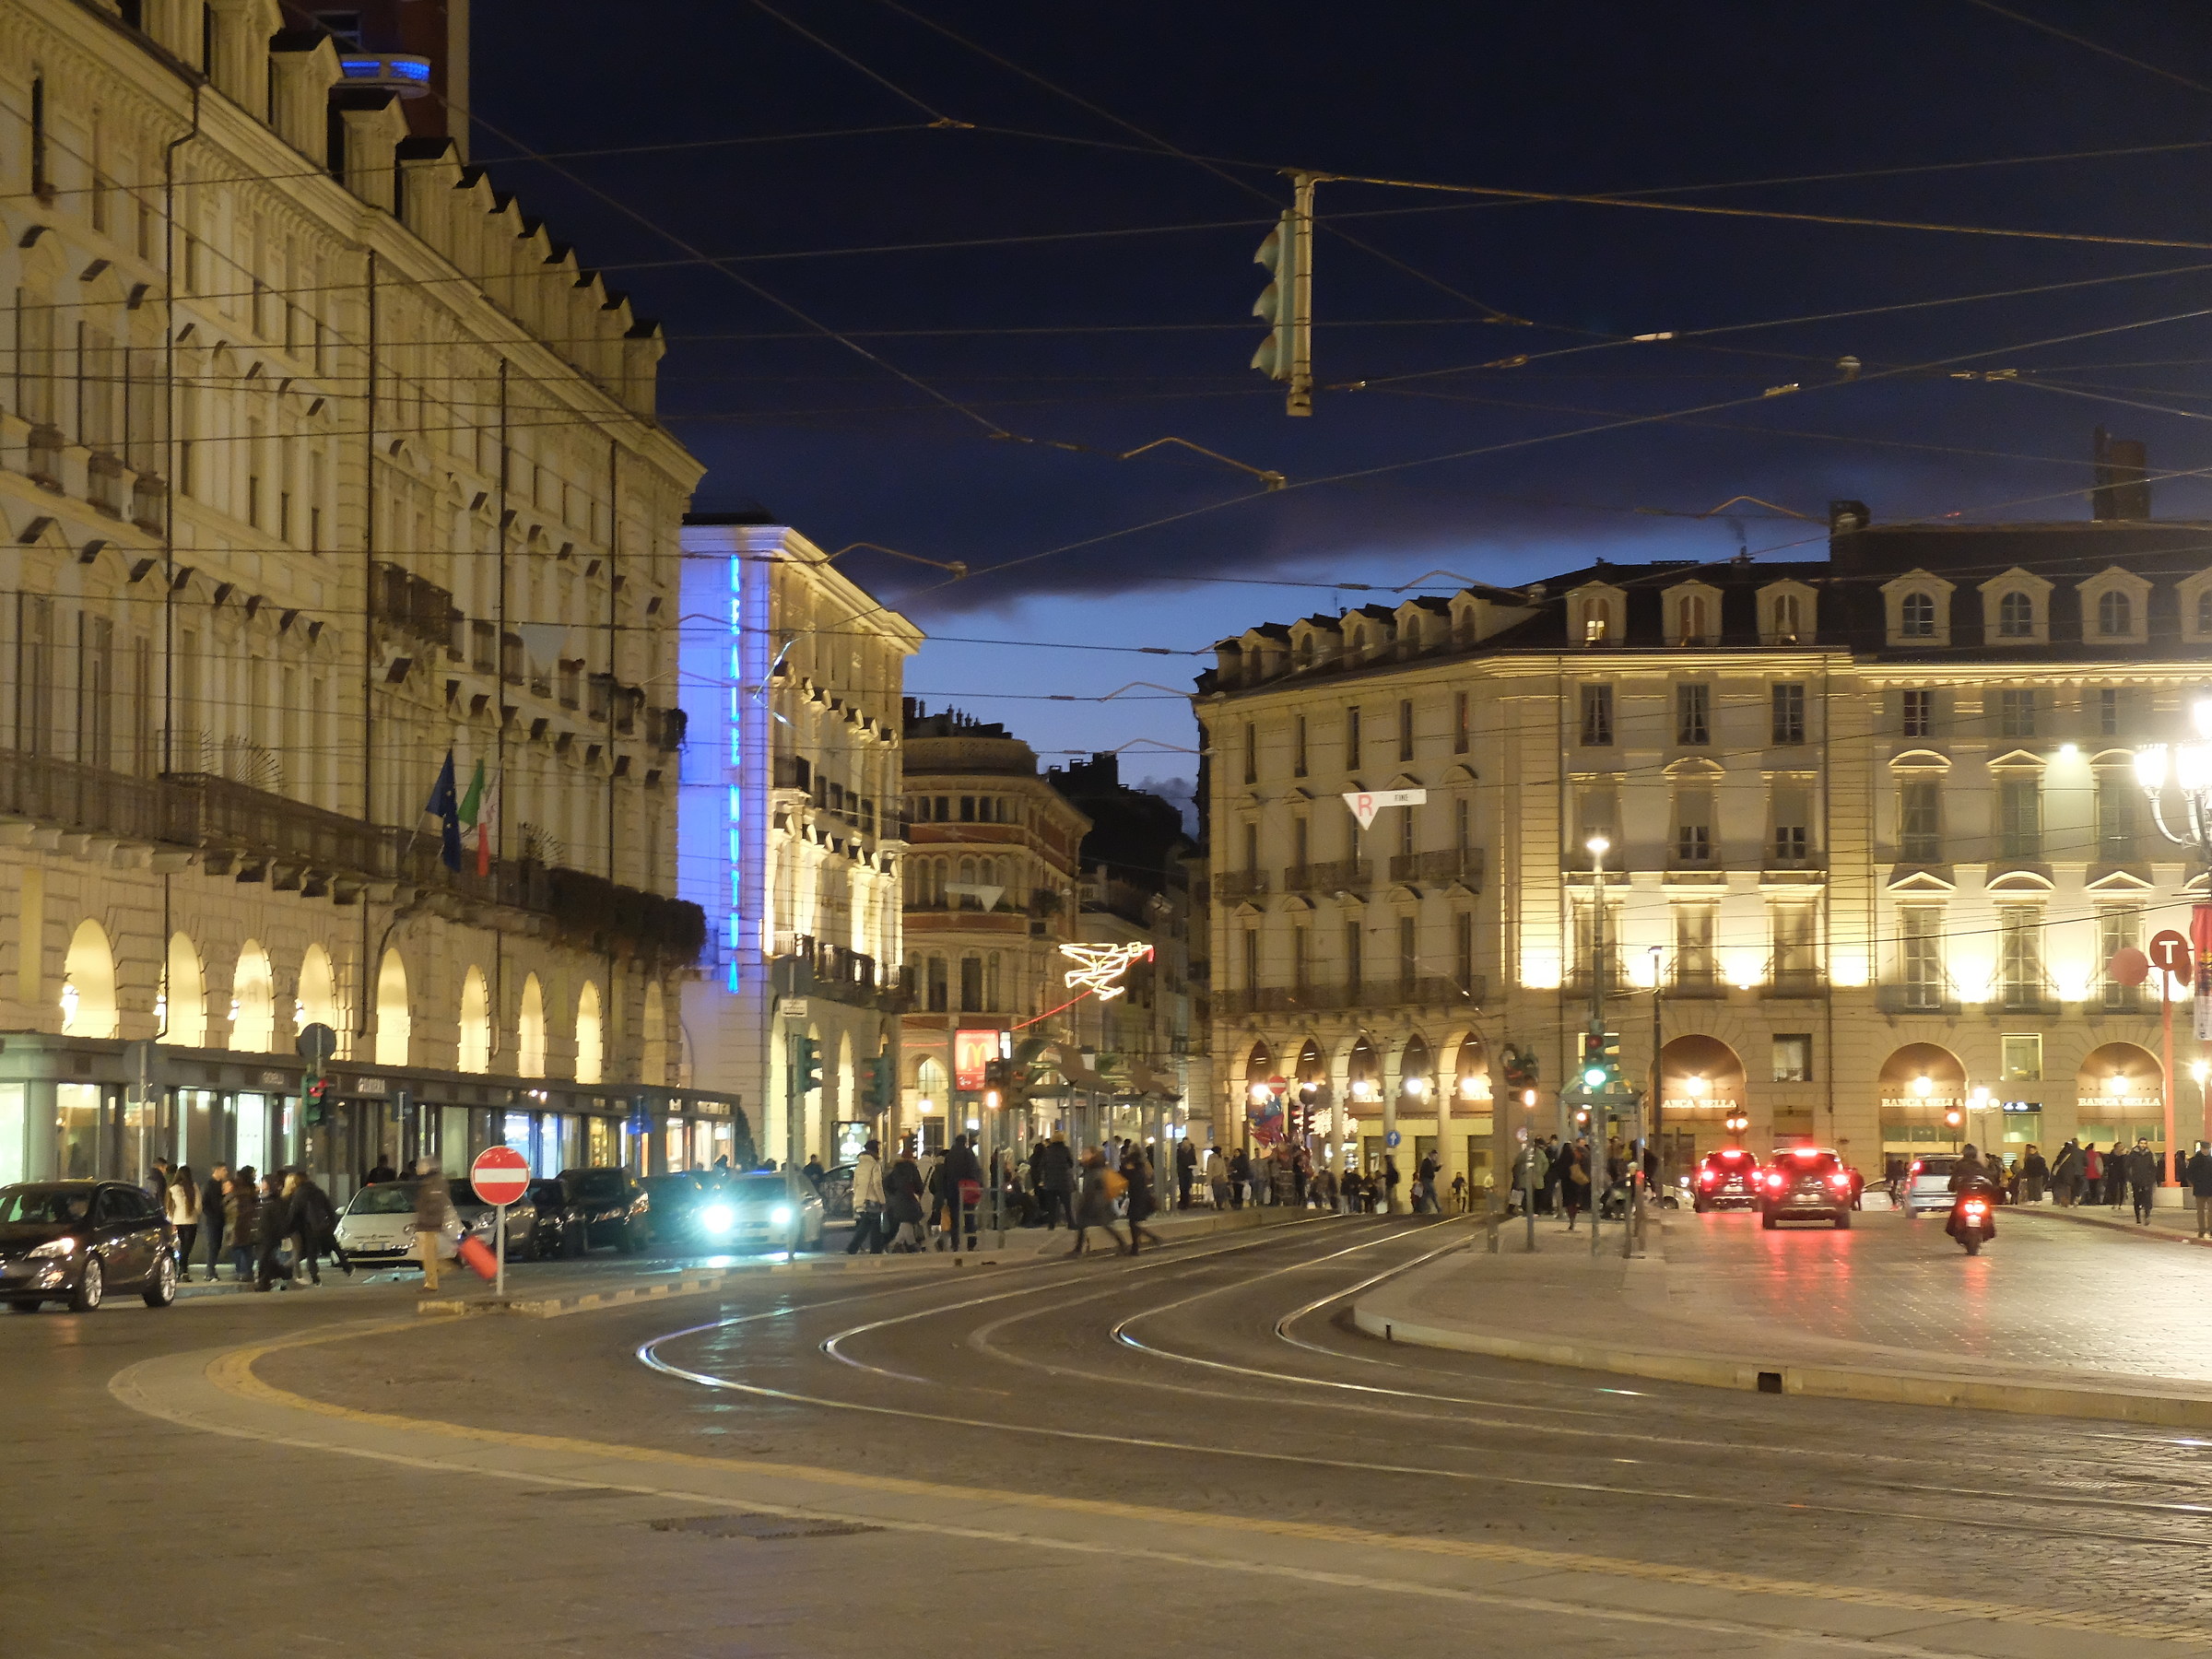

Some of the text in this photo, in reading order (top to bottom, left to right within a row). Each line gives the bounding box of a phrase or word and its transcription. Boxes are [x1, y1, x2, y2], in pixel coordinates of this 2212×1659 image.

[1358, 794, 1372, 817] R
[2159, 940, 2179, 964] T
[1881, 1098, 1924, 1107] BANCA
[2077, 1097, 2162, 1107] BANCA SELLA
